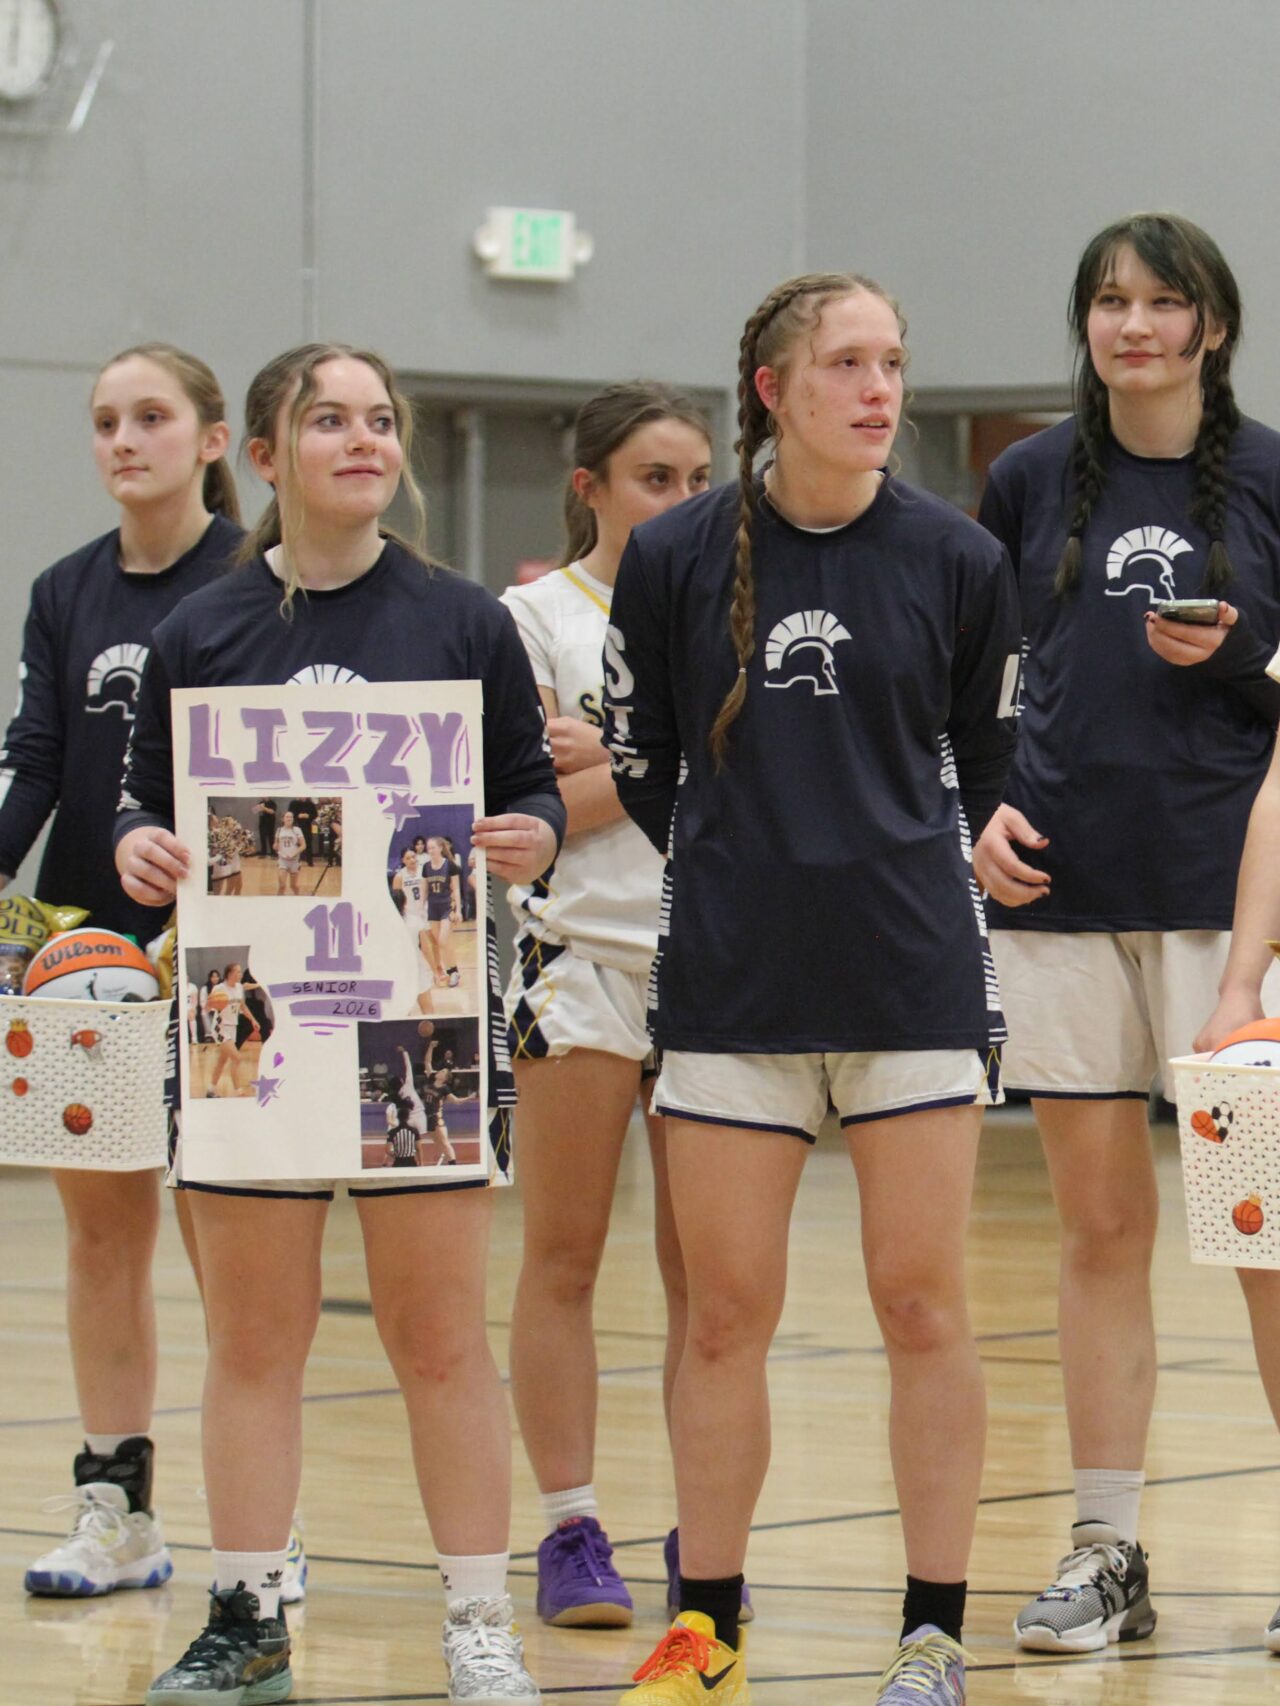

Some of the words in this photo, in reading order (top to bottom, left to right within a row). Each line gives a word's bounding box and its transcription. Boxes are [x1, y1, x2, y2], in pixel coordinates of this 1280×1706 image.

[512, 211, 564, 268] EXIT
[412, 886, 421, 901] 8
[303, 902, 362, 972] 11
[42, 939, 123, 970] Wilson
[292, 981, 357, 994] SENIOR
[332, 1001, 377, 1015] 2026
